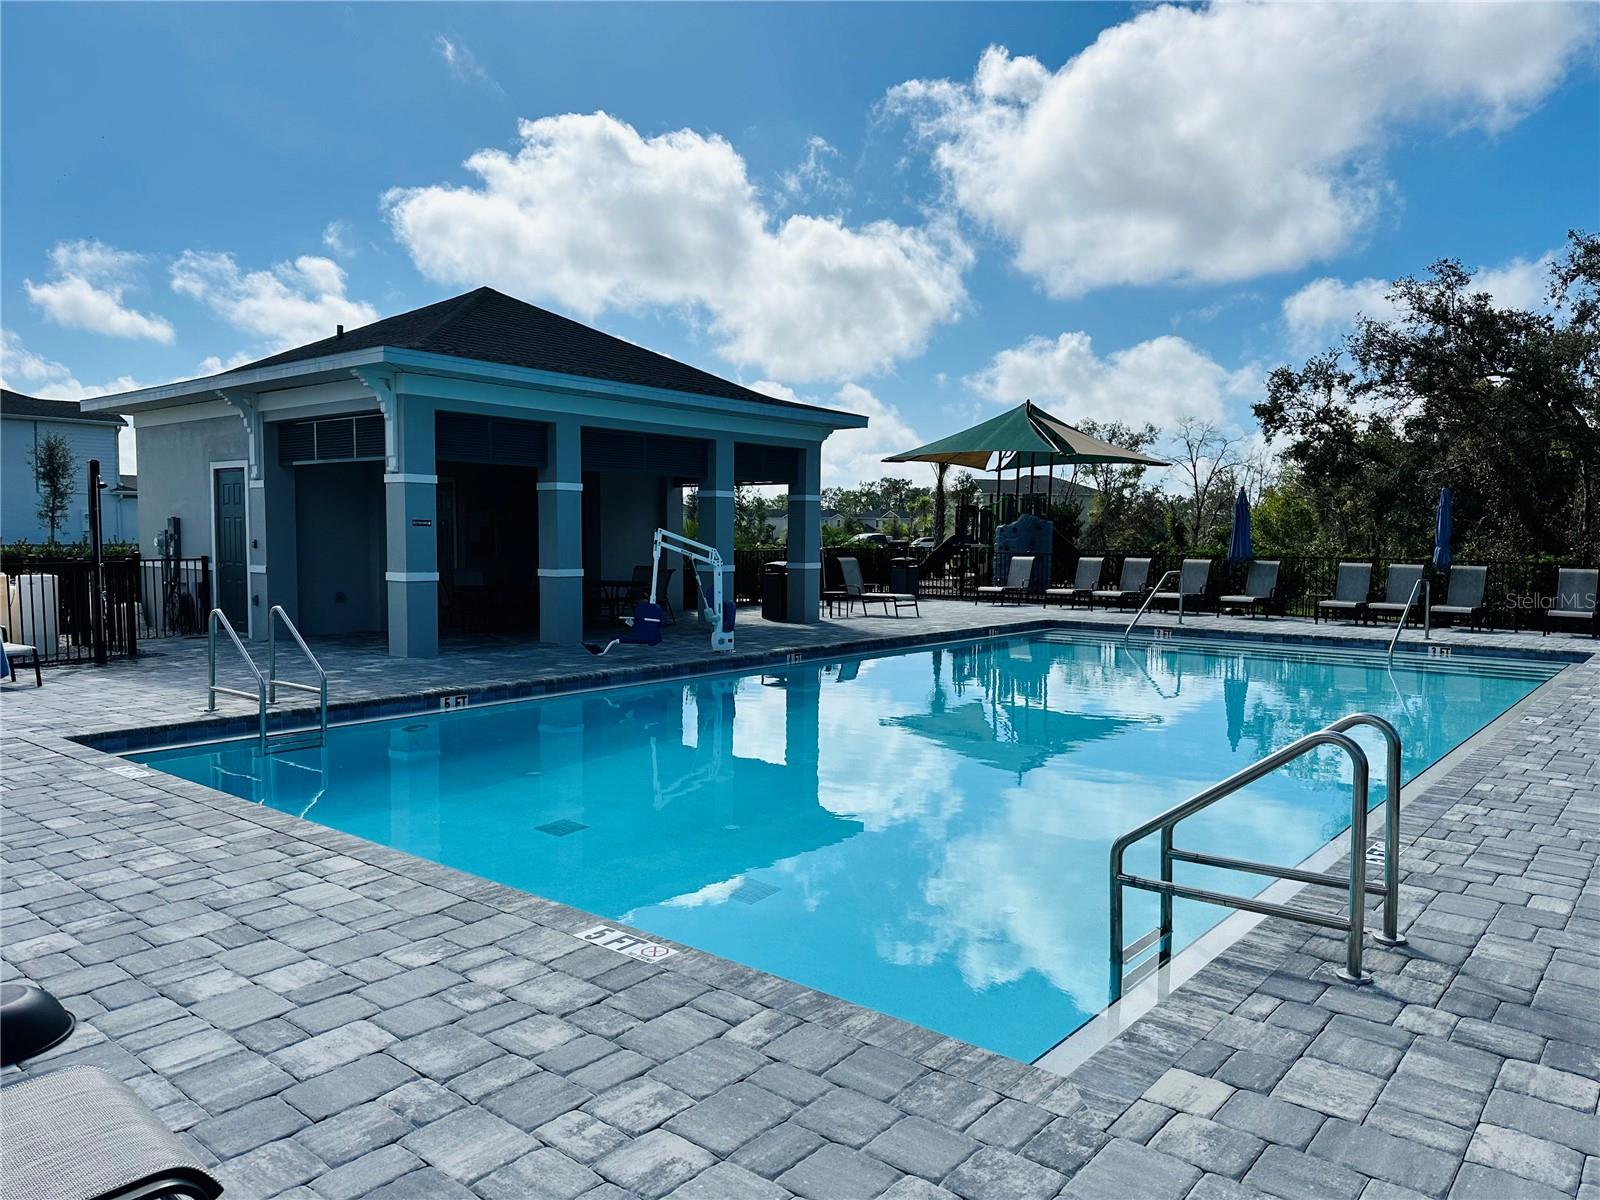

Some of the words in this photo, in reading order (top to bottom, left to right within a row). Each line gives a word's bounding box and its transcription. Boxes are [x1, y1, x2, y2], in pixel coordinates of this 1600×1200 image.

[1440, 647, 1451, 657] FT
[455, 695, 468, 707] FT
[585, 928, 616, 940] 5
[603, 934, 649, 951] FT
